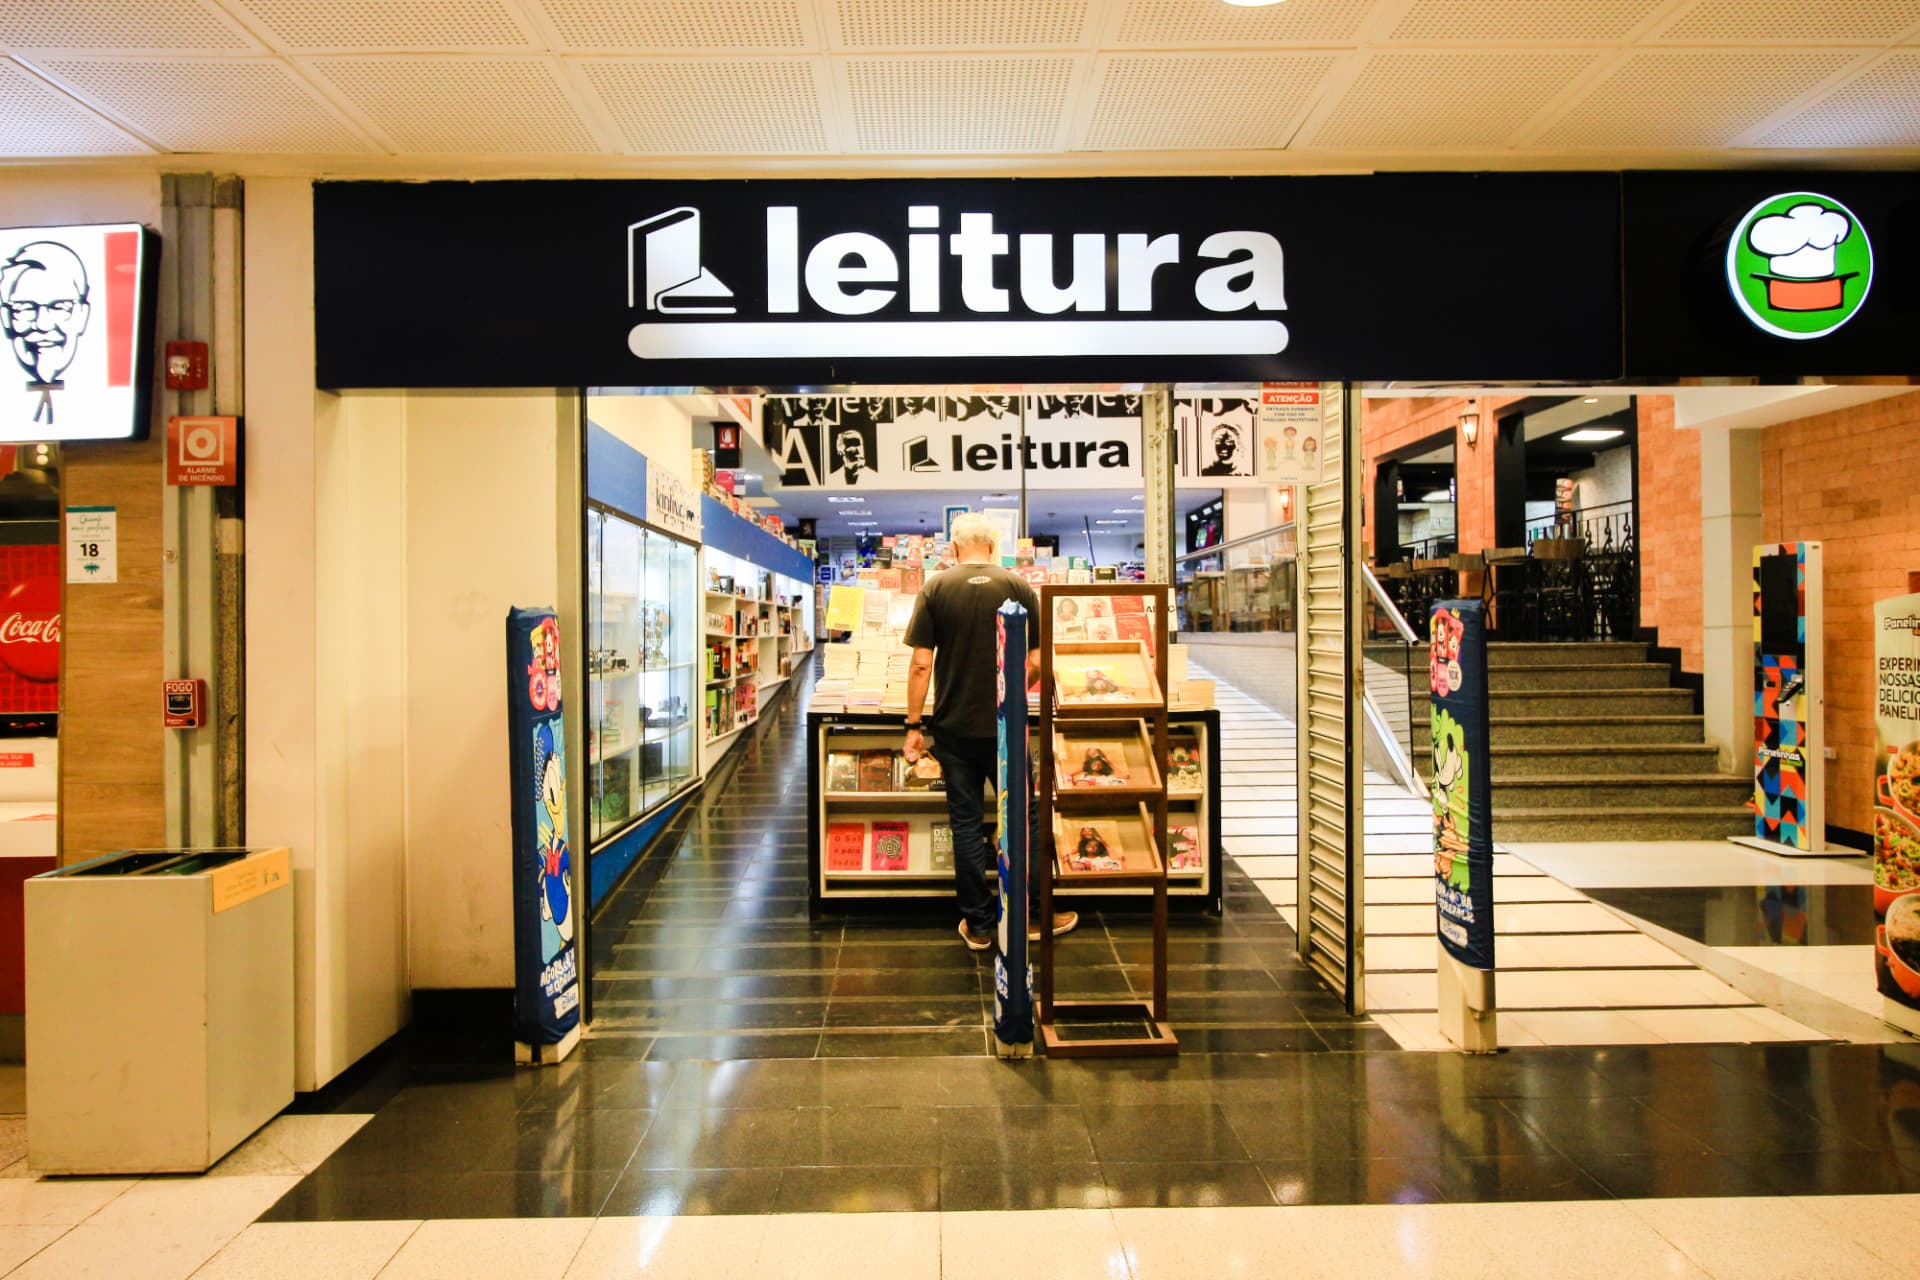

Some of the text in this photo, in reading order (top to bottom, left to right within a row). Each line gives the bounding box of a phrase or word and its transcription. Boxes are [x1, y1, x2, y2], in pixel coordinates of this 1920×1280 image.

[766, 205, 1288, 315] leitura
[1268, 393, 1313, 404] ATENÇÃO
[951, 433, 1130, 472] leitura
[186, 466, 217, 474] ALARME
[190, 473, 225, 481] INCÊNDIO
[80, 543, 99, 557] 18
[166, 682, 193, 692] FOGO
[1879, 704, 1920, 721] PANELI
